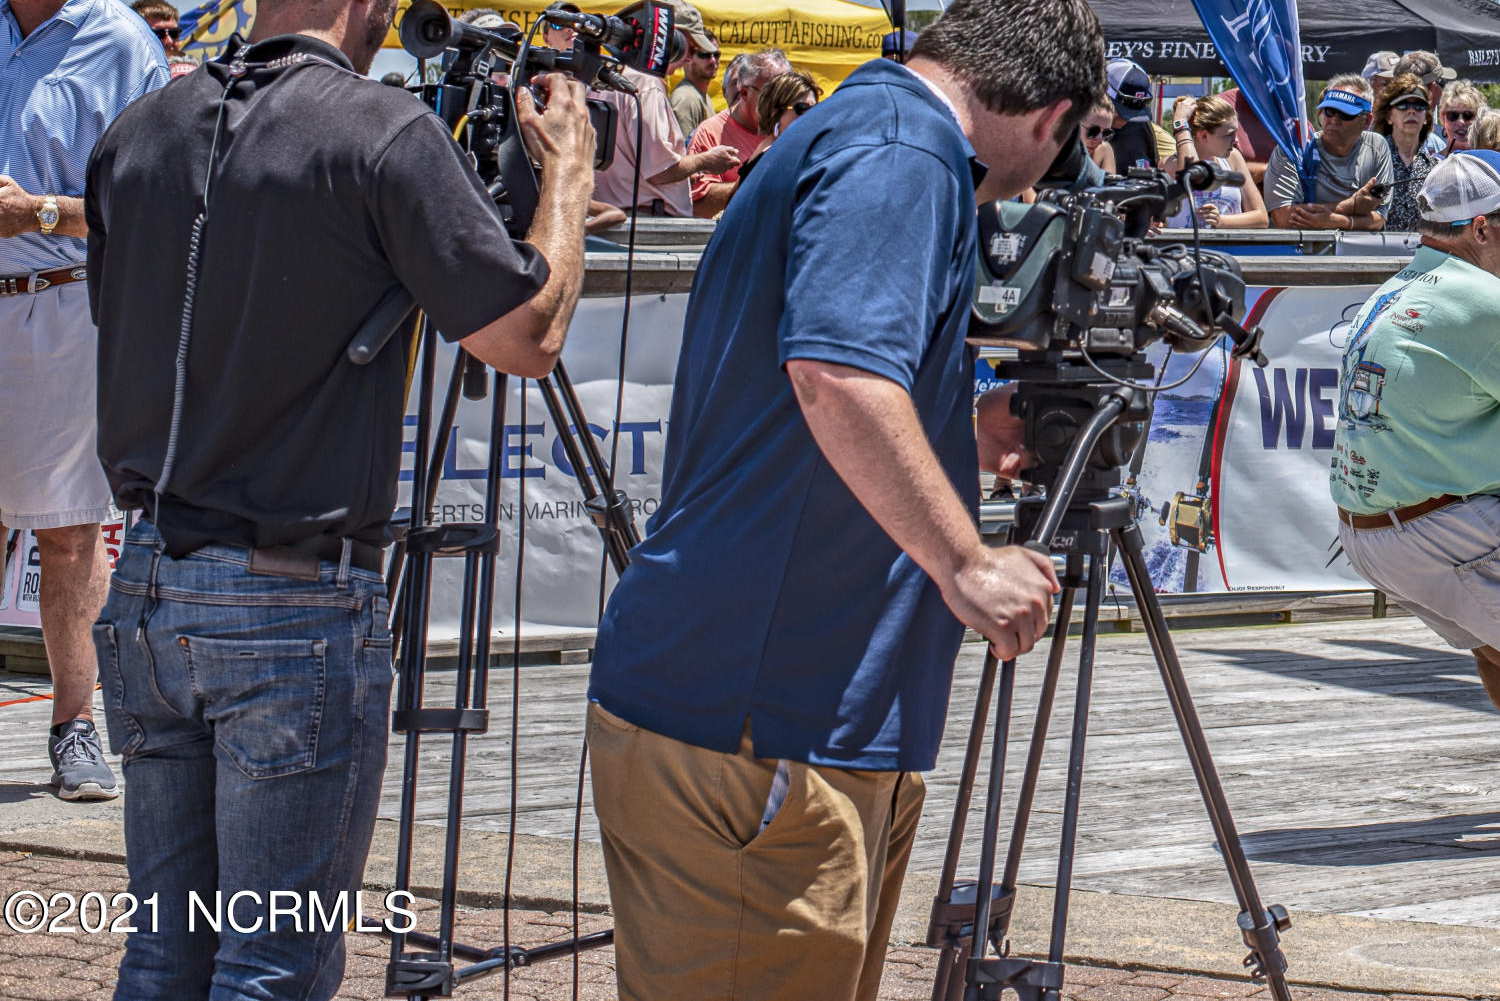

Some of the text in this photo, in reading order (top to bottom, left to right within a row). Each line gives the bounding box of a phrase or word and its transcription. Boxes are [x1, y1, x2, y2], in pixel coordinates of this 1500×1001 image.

[653, 7, 668, 66] WITN
[1158, 41, 1217, 60] FINE
[1333, 91, 1356, 104] YAMAHA
[1002, 289, 1016, 303] 4A
[399, 414, 669, 482] ELECT
[525, 499, 589, 520] MARIN
